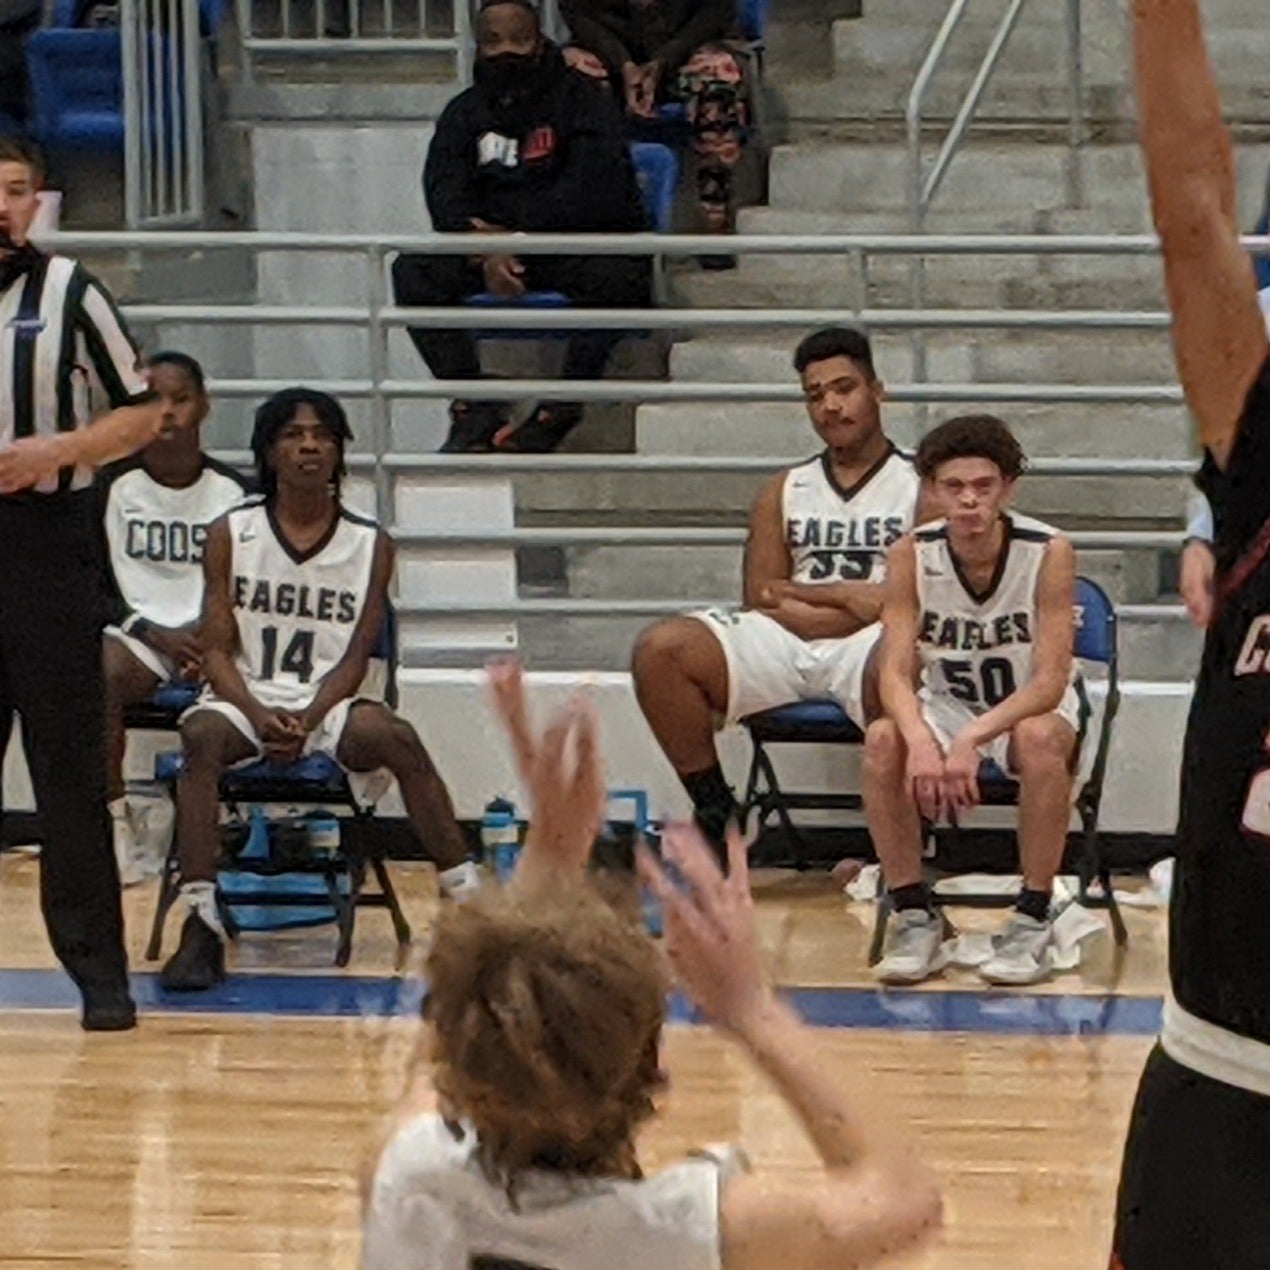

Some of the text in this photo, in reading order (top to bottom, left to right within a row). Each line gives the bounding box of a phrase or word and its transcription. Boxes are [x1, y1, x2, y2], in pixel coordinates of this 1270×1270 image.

[788, 517, 903, 547] EAGLES
[234, 575, 356, 624] EAGLES
[261, 625, 315, 683] 14
[920, 611, 1032, 650] EAGLES
[941, 657, 1016, 706] 50
